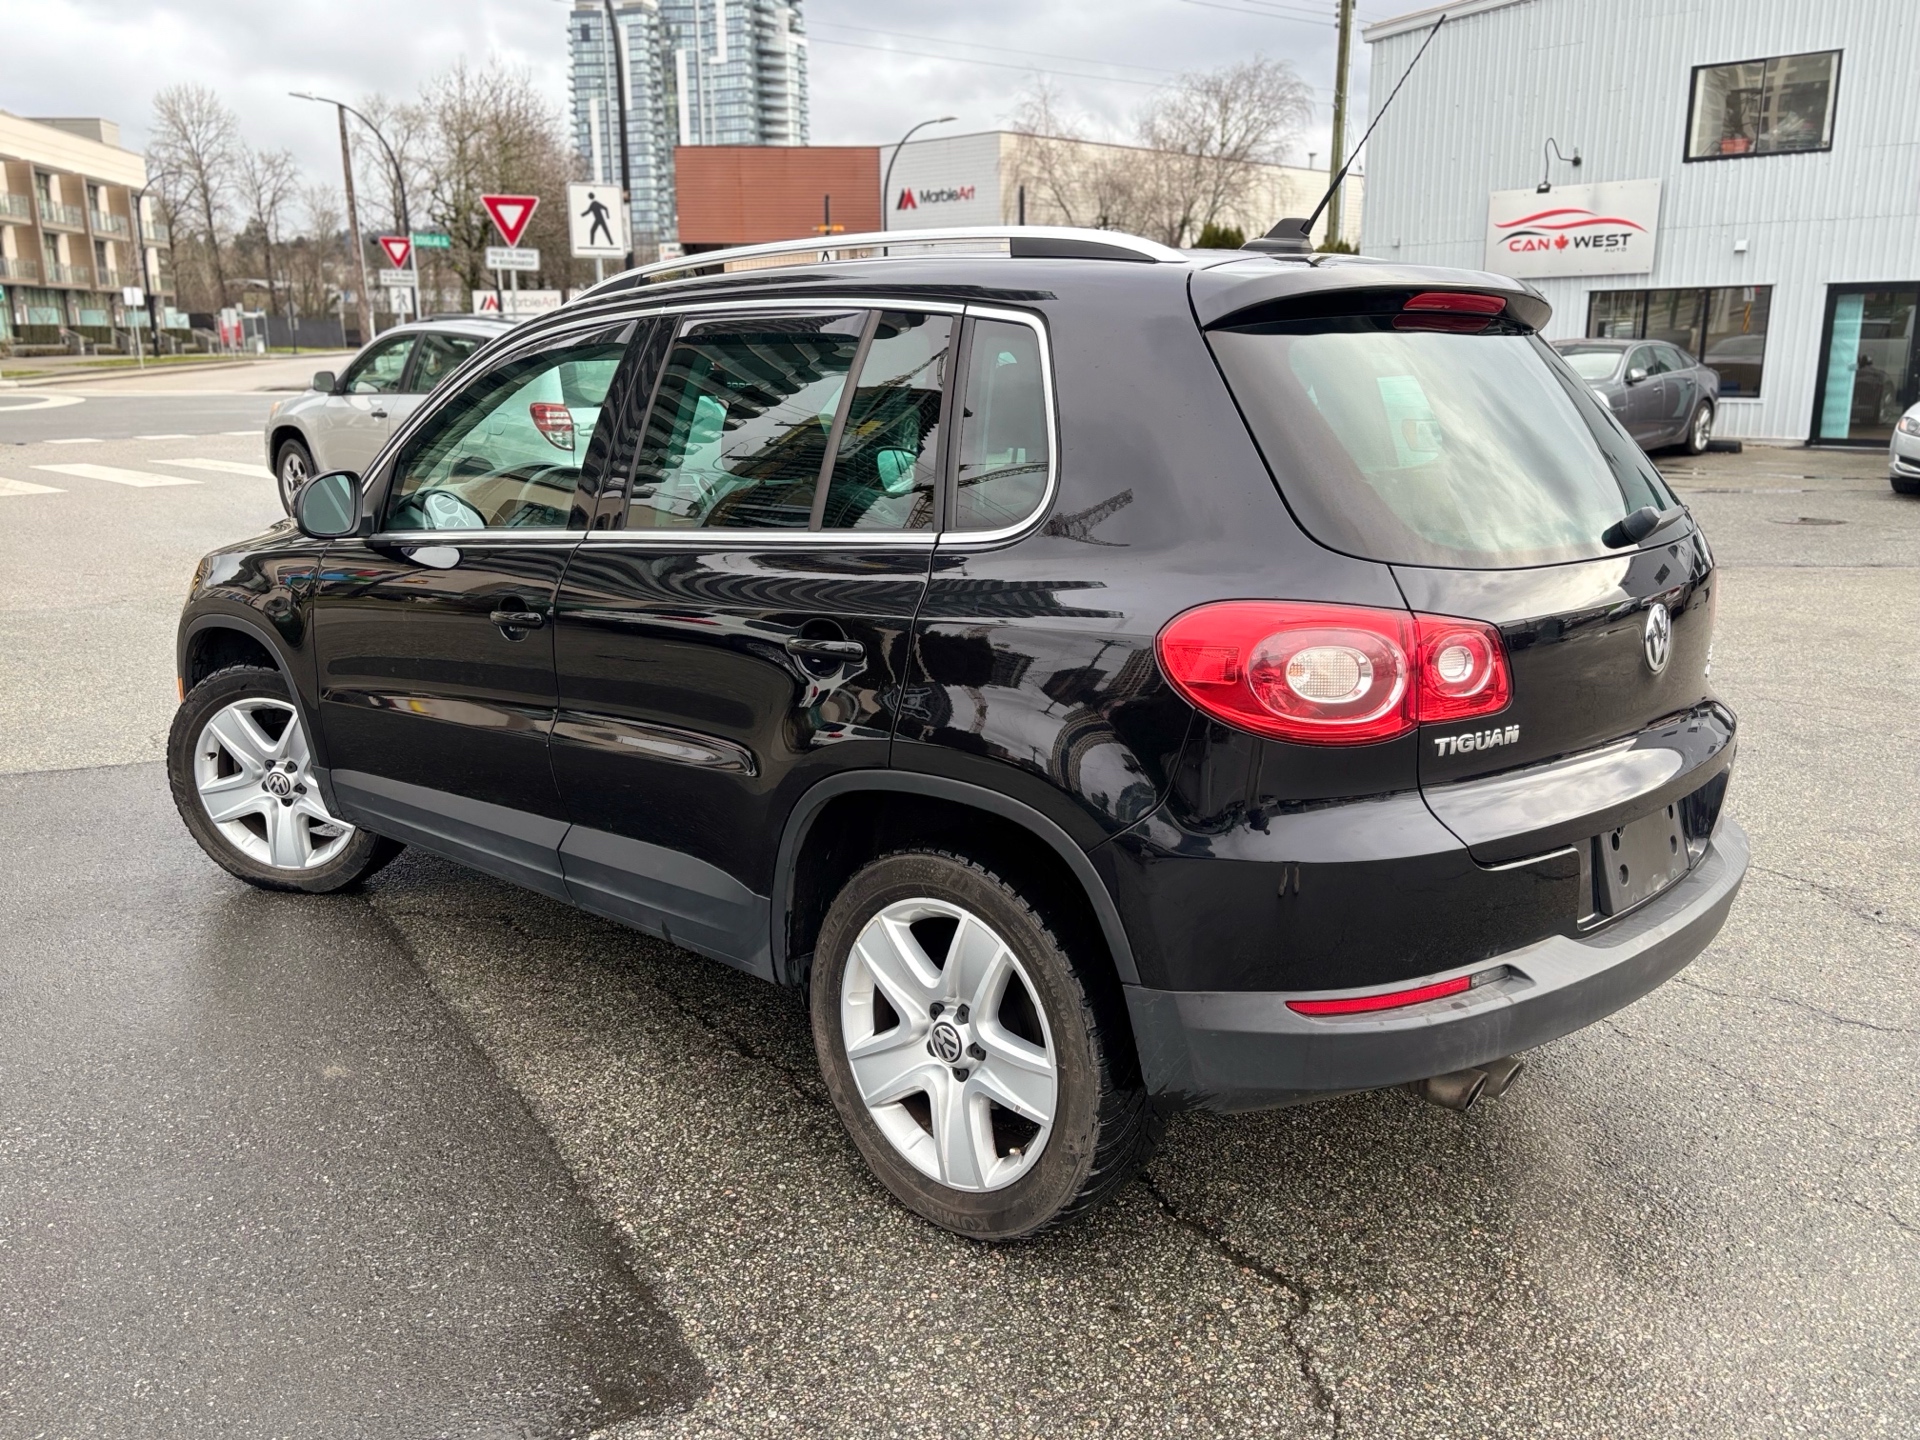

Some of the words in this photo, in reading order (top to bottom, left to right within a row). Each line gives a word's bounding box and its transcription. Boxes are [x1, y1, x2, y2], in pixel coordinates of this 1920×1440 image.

[920, 185, 975, 203] MarbleArt
[1508, 239, 1551, 252] CAN
[1573, 232, 1633, 249] WEST
[1434, 724, 1520, 757] TIGUAN
[912, 1193, 990, 1231] KUMHO
